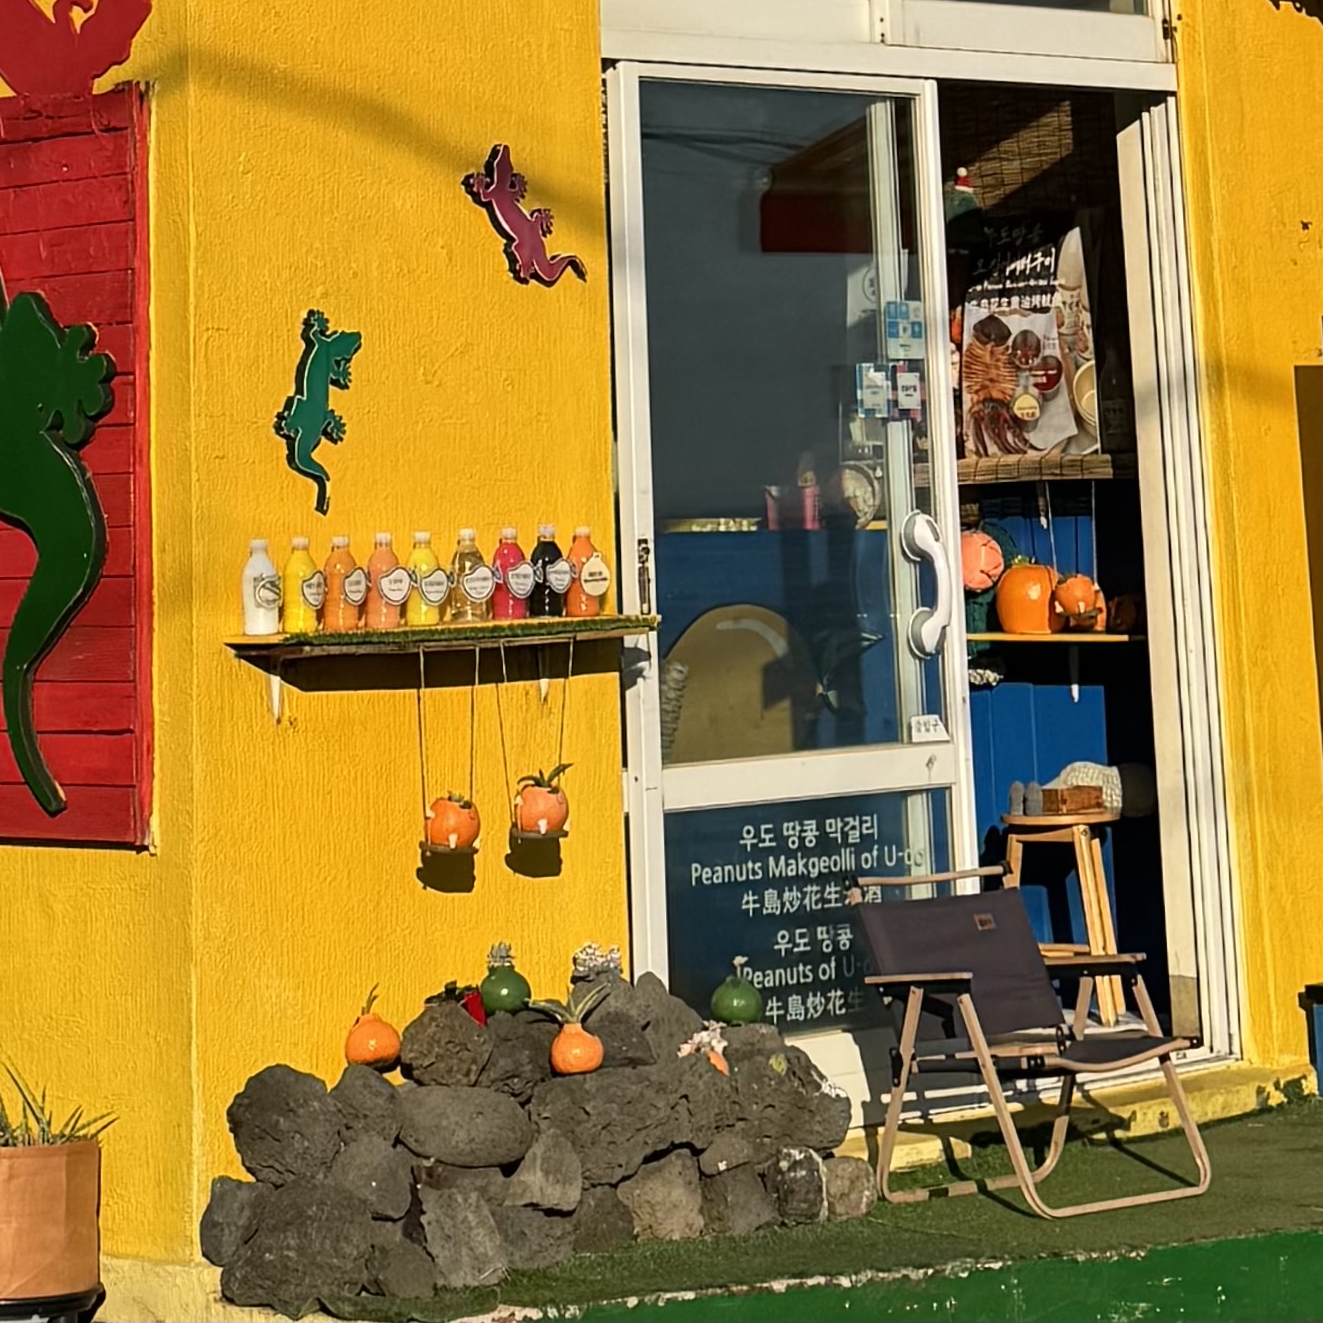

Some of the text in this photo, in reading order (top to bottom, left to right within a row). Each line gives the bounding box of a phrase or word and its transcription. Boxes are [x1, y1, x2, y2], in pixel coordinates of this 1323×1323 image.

[739, 813, 879, 852] 우도 땅콩 막걸리
[691, 858, 763, 886] Peanuts
[768, 847, 856, 880] Makgeolli
[861, 844, 879, 870] of
[741, 880, 882, 918] 牛島炒花生酒
[773, 923, 854, 958] 우도 땅콩
[743, 961, 814, 989] Peanuts
[818, 955, 837, 980] of
